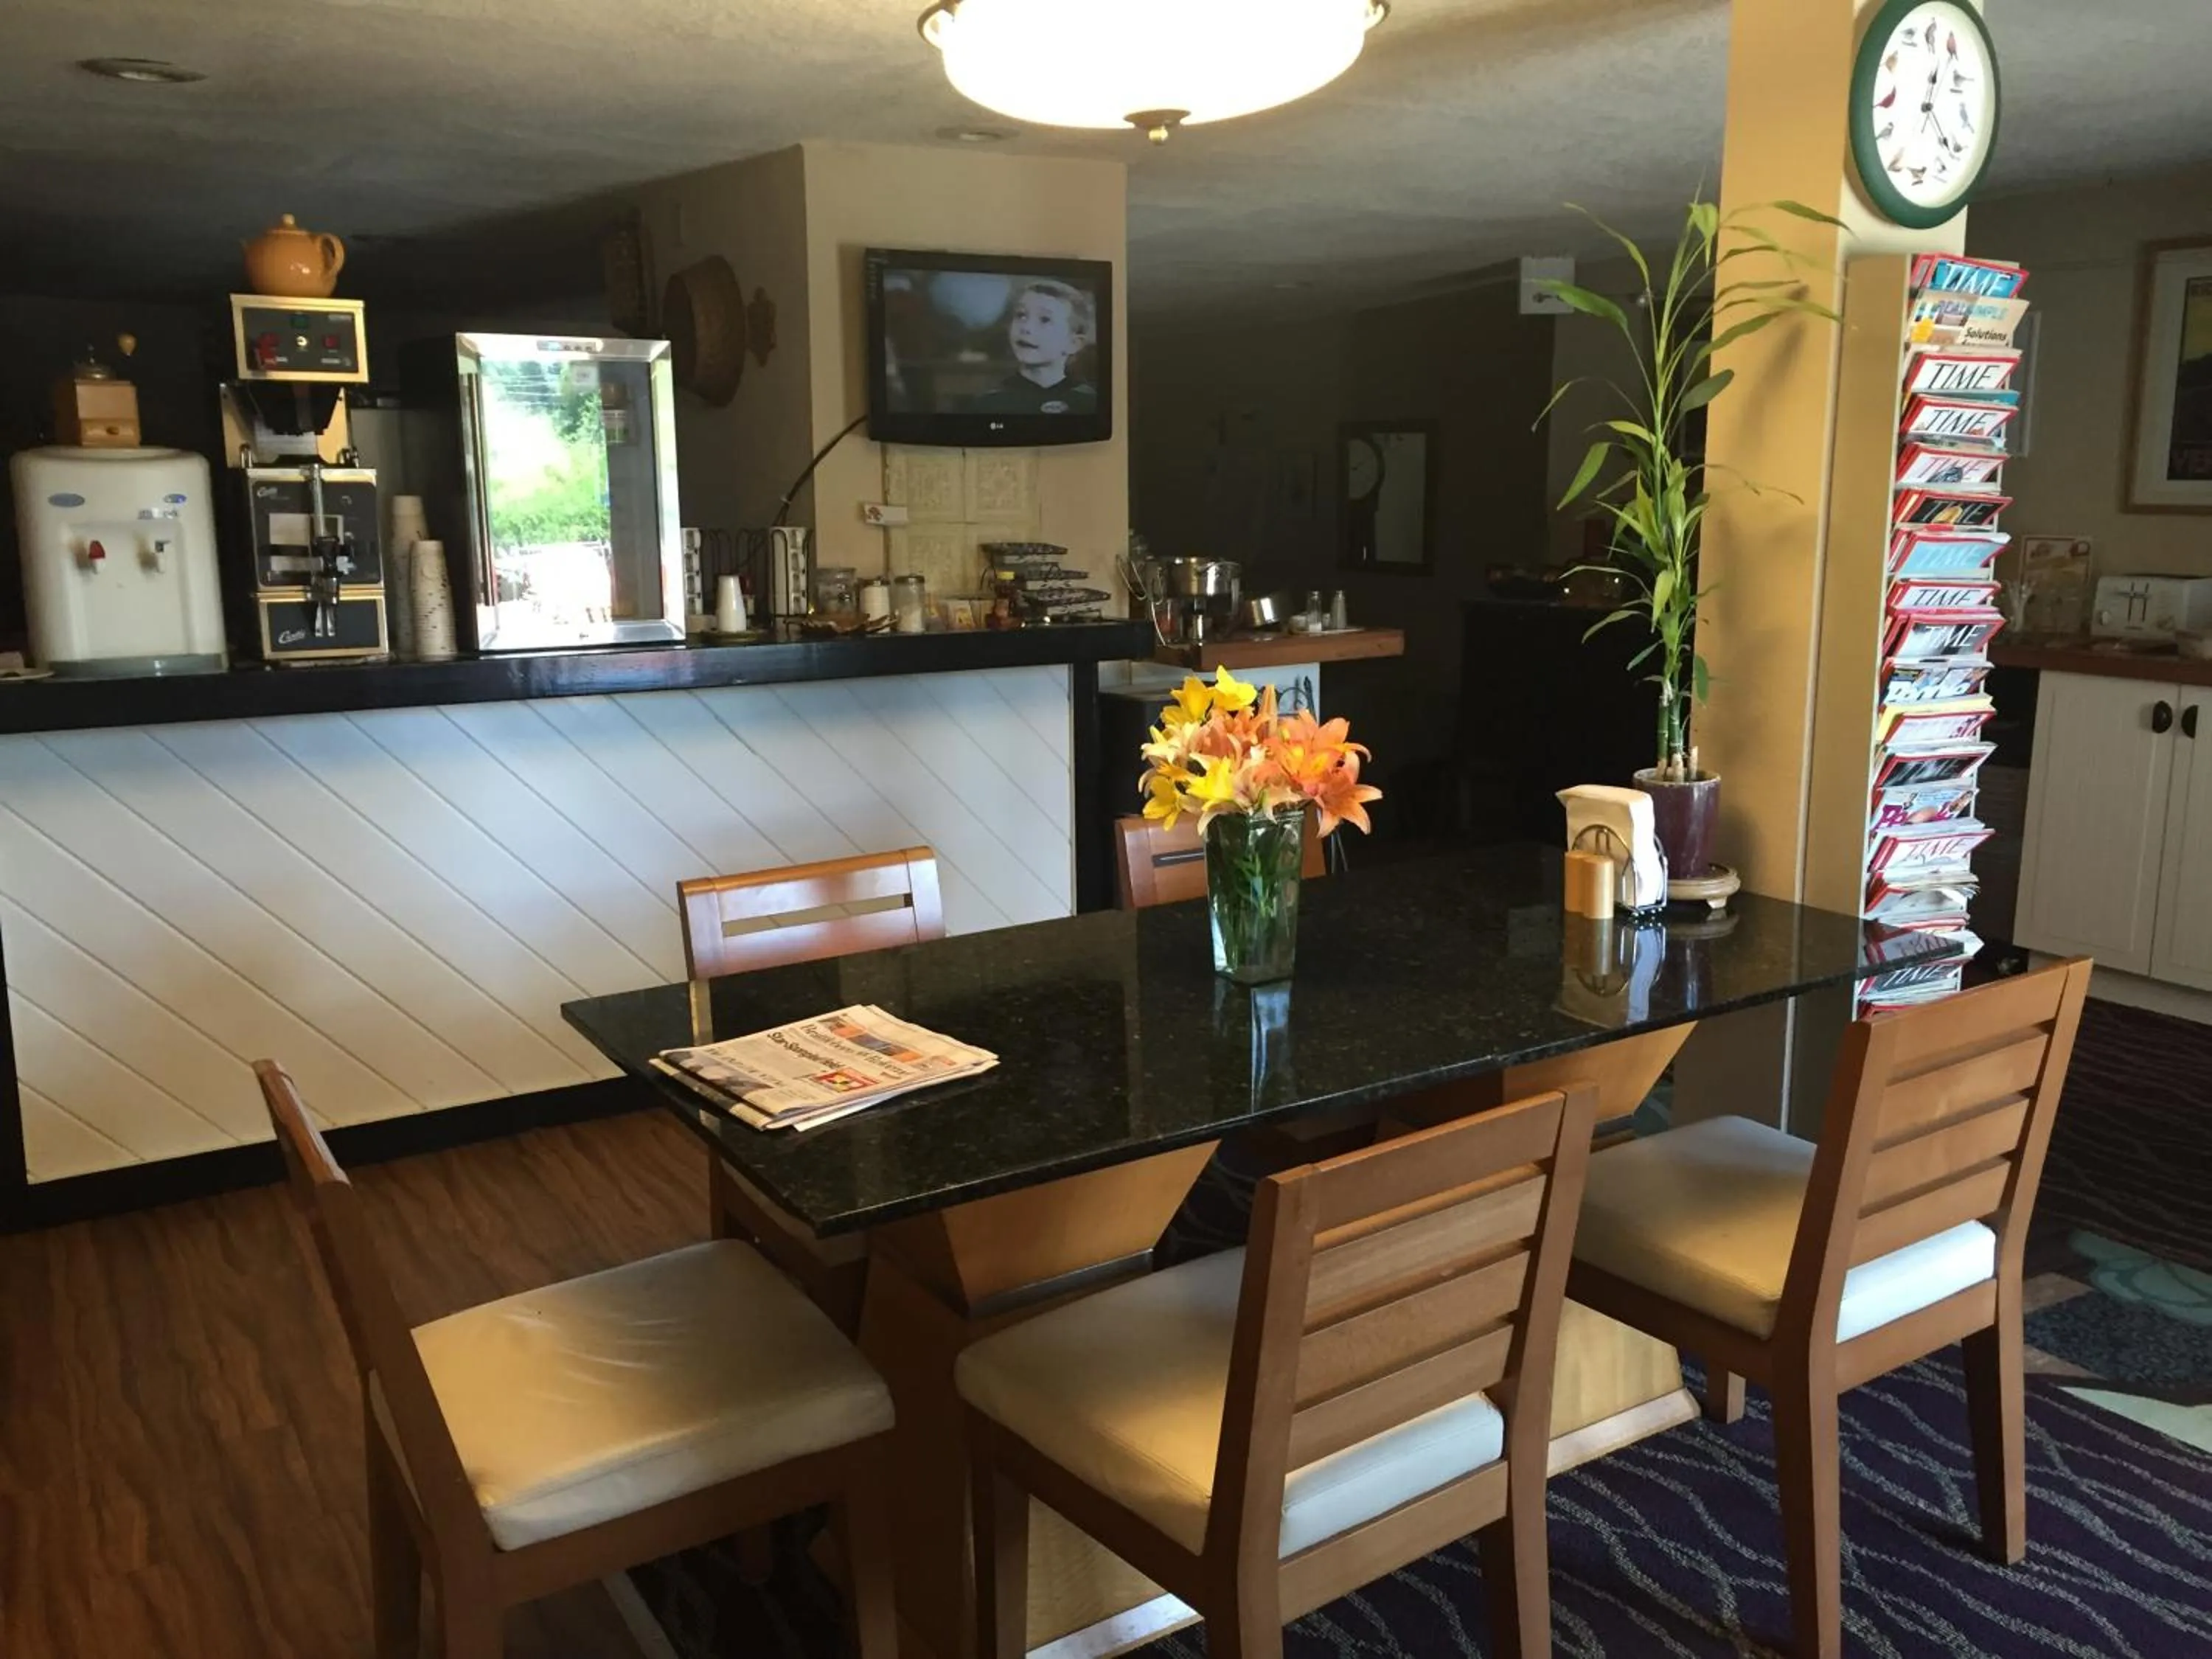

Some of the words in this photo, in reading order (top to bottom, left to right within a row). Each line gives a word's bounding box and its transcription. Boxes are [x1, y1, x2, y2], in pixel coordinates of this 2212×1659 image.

[1941, 262, 2013, 296] TIME
[1964, 327, 2008, 341] Solutions
[1927, 362, 2000, 390] TIME
[1925, 409, 1996, 434] TIME
[1922, 501, 1994, 524] TE
[1913, 589, 1980, 606] TIME
[1923, 625, 1986, 647] TIME
[1882, 964, 1948, 987] TIME
